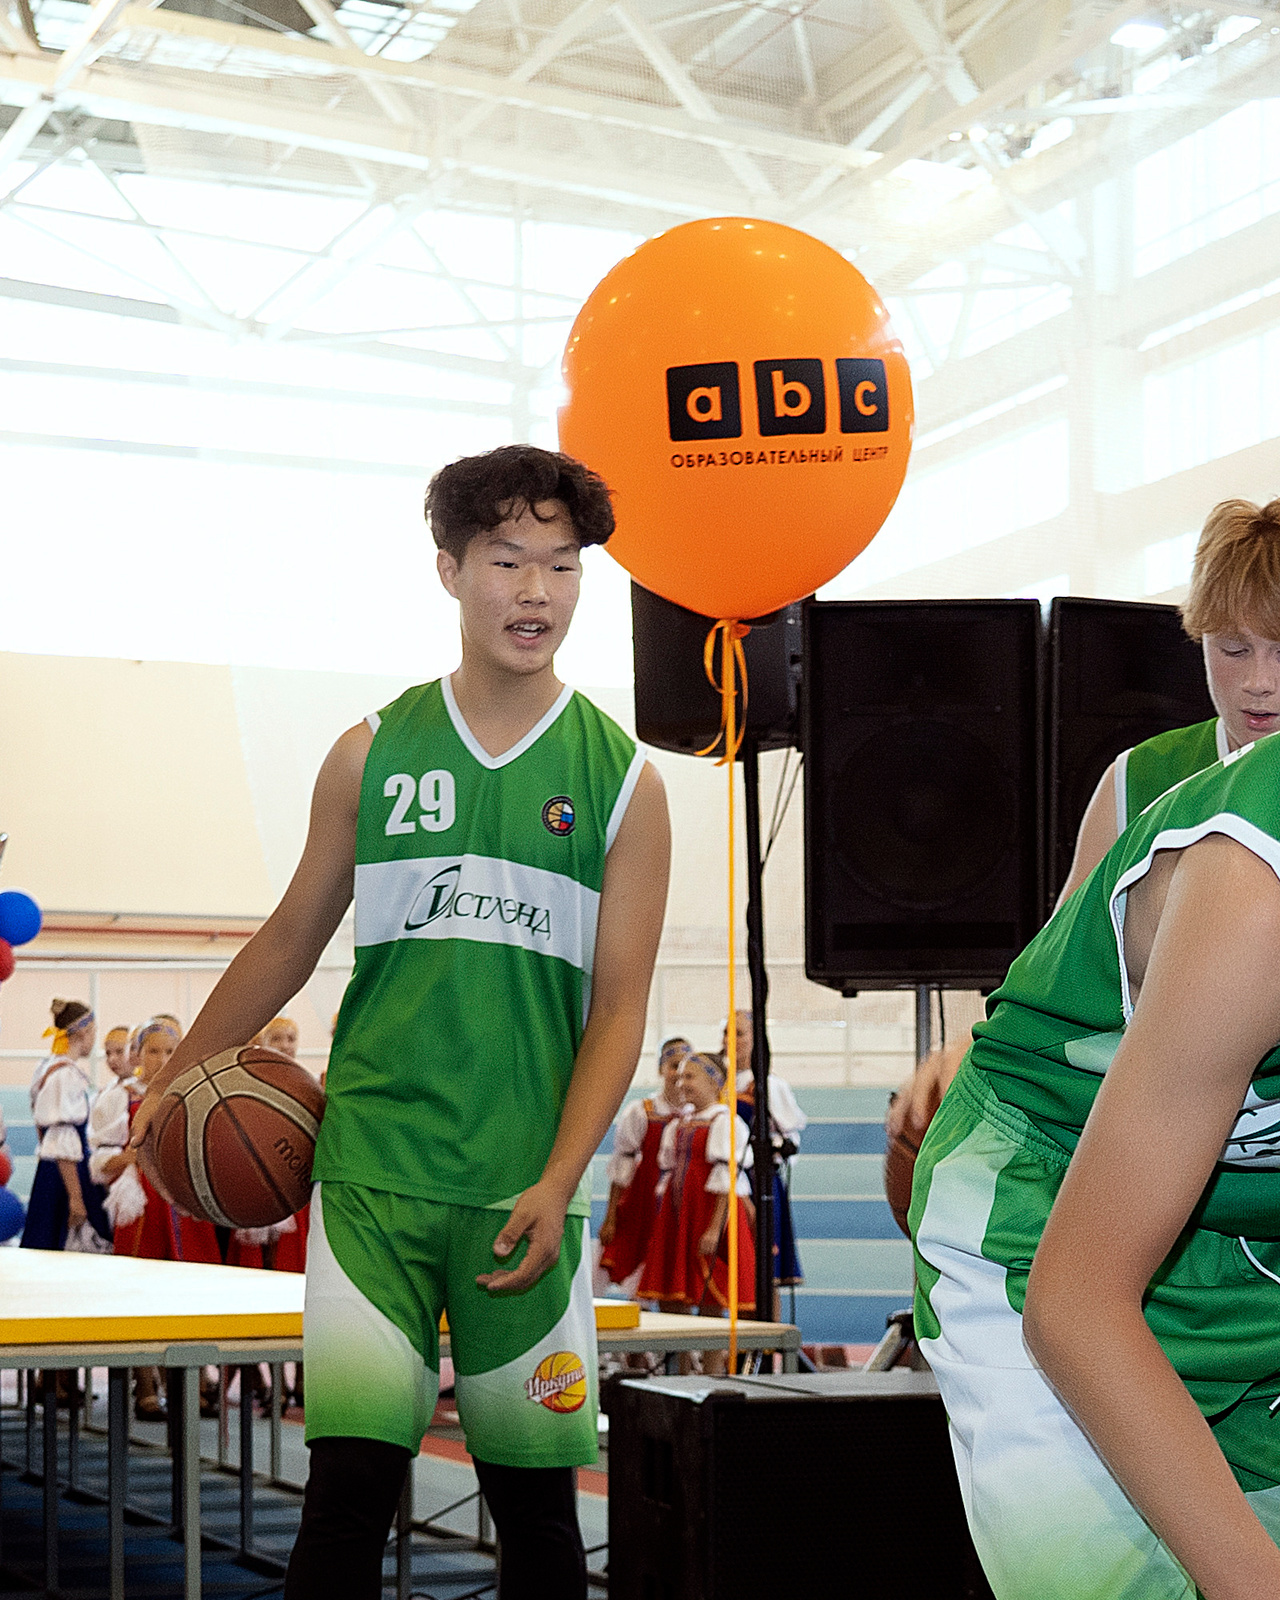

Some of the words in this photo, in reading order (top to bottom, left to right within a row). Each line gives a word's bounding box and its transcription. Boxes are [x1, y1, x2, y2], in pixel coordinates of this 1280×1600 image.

[686, 370, 878, 423] abc
[670, 446, 843, 468] ОБРАЗОВАТЕЛЬНЫЙ
[383, 769, 456, 836] 29
